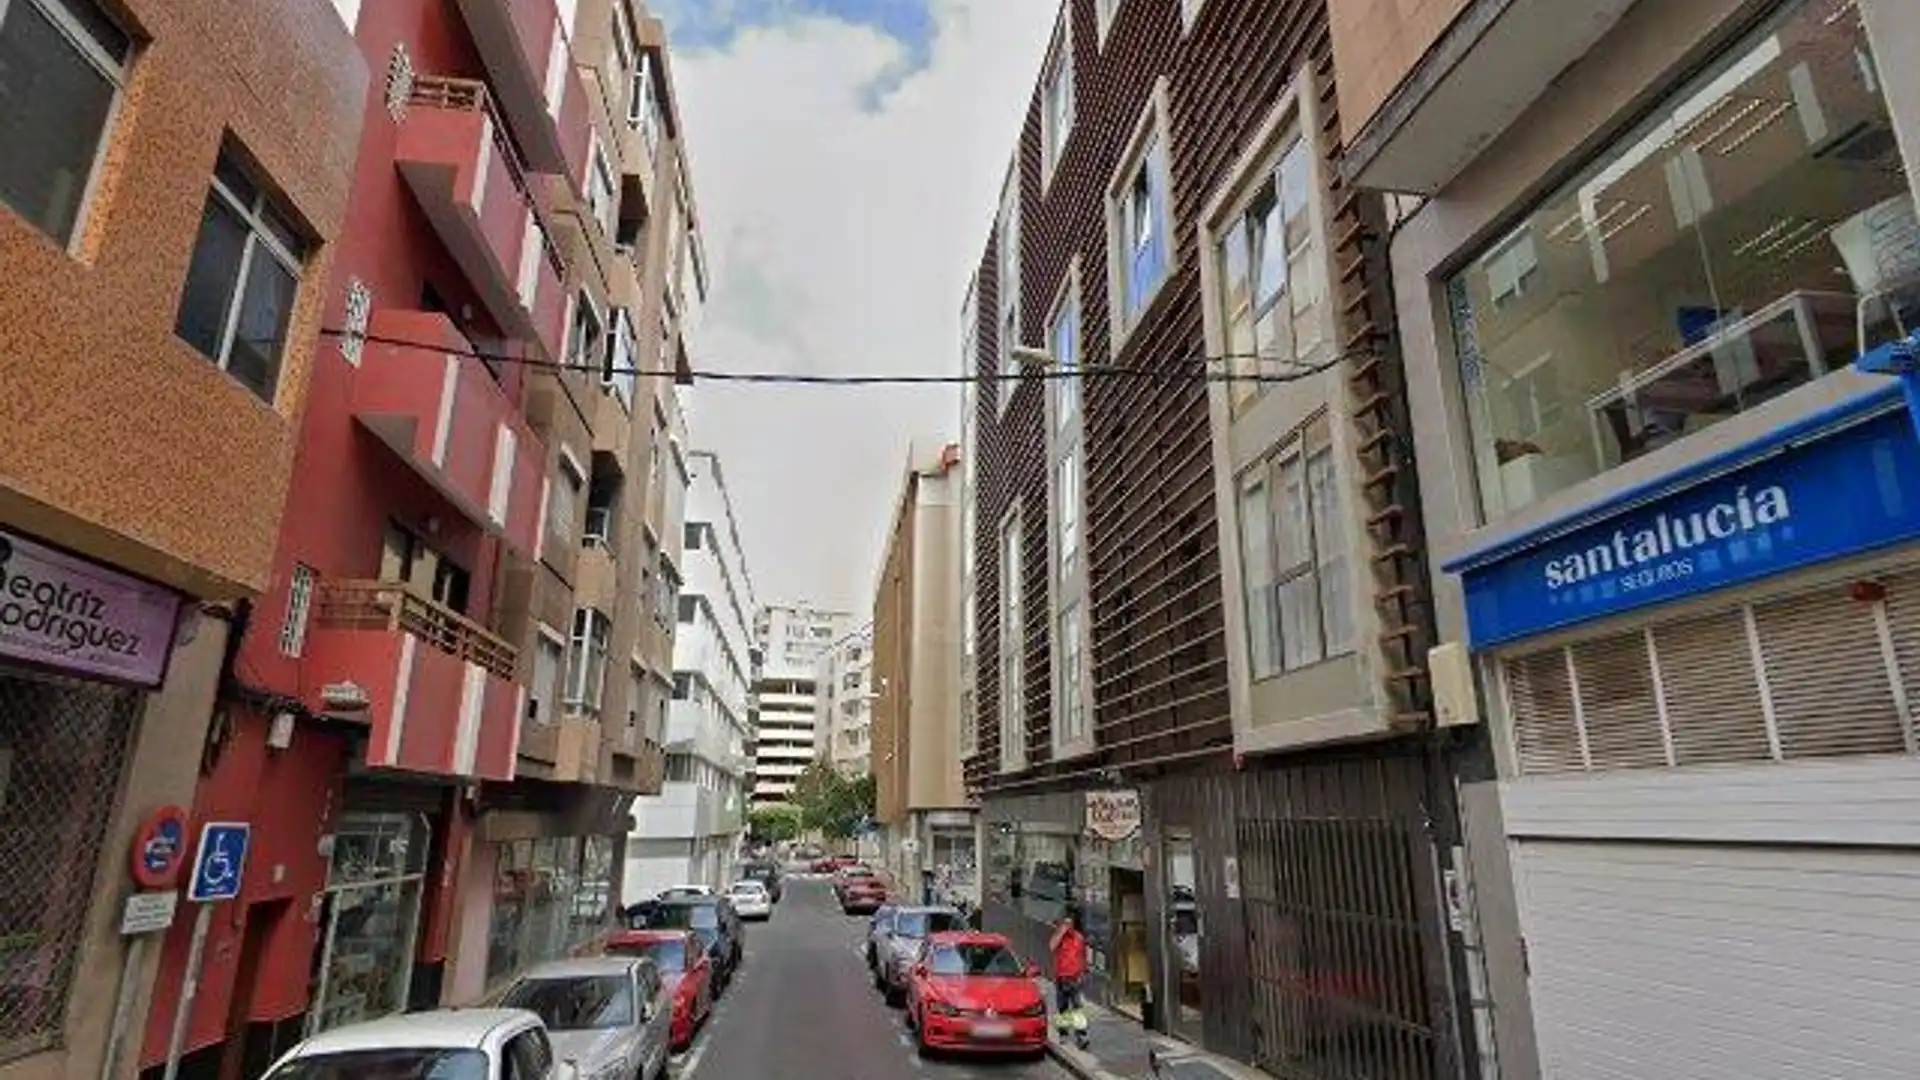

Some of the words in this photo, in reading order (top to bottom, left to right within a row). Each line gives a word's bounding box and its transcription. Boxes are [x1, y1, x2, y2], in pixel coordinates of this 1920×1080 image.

[1545, 485, 1790, 589] santalucía
[0, 568, 105, 620] eatriz
[0, 601, 141, 655] odriguez
